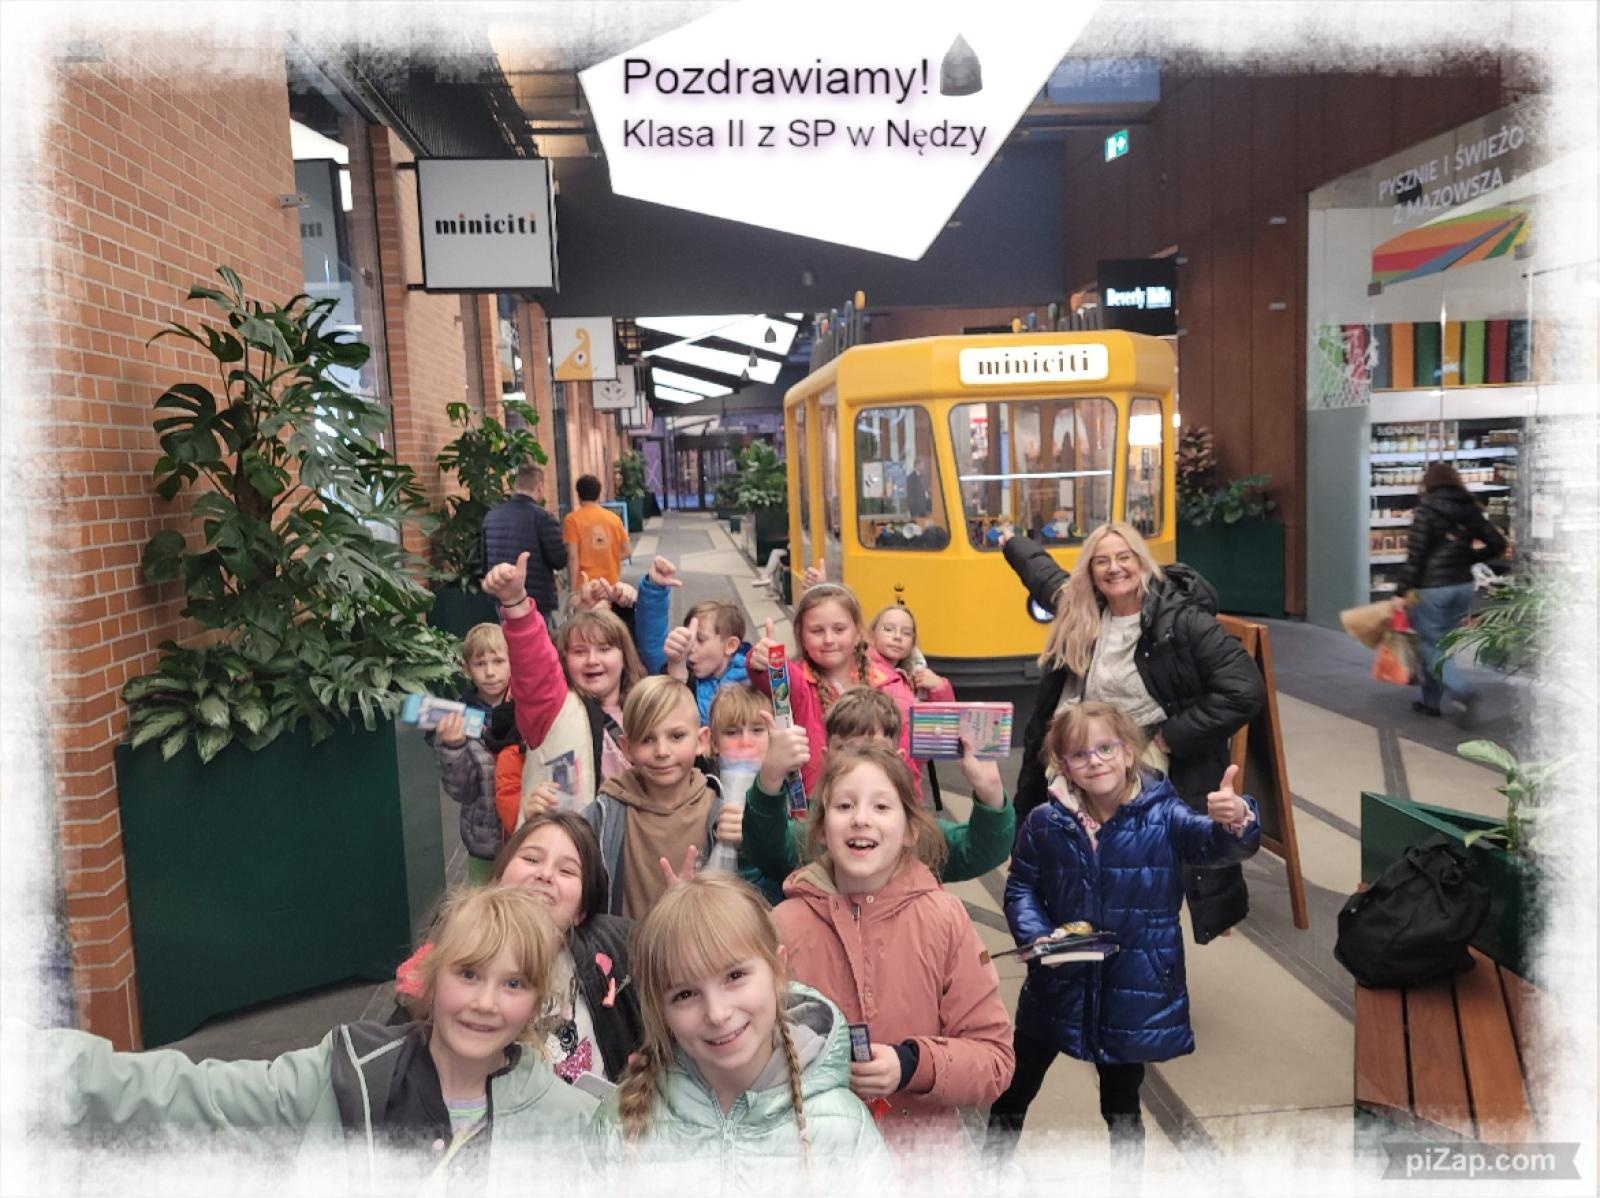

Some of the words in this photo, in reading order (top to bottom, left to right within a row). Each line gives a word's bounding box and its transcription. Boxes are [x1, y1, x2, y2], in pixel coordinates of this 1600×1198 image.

[1378, 160, 1438, 201] PYSZNIE
[1443, 155, 1449, 175] I
[1455, 126, 1524, 171] ŚWIEŻO
[1406, 166, 1504, 220] MAZOWSZA
[435, 213, 536, 235] miniciti
[978, 350, 1089, 375] miniciti
